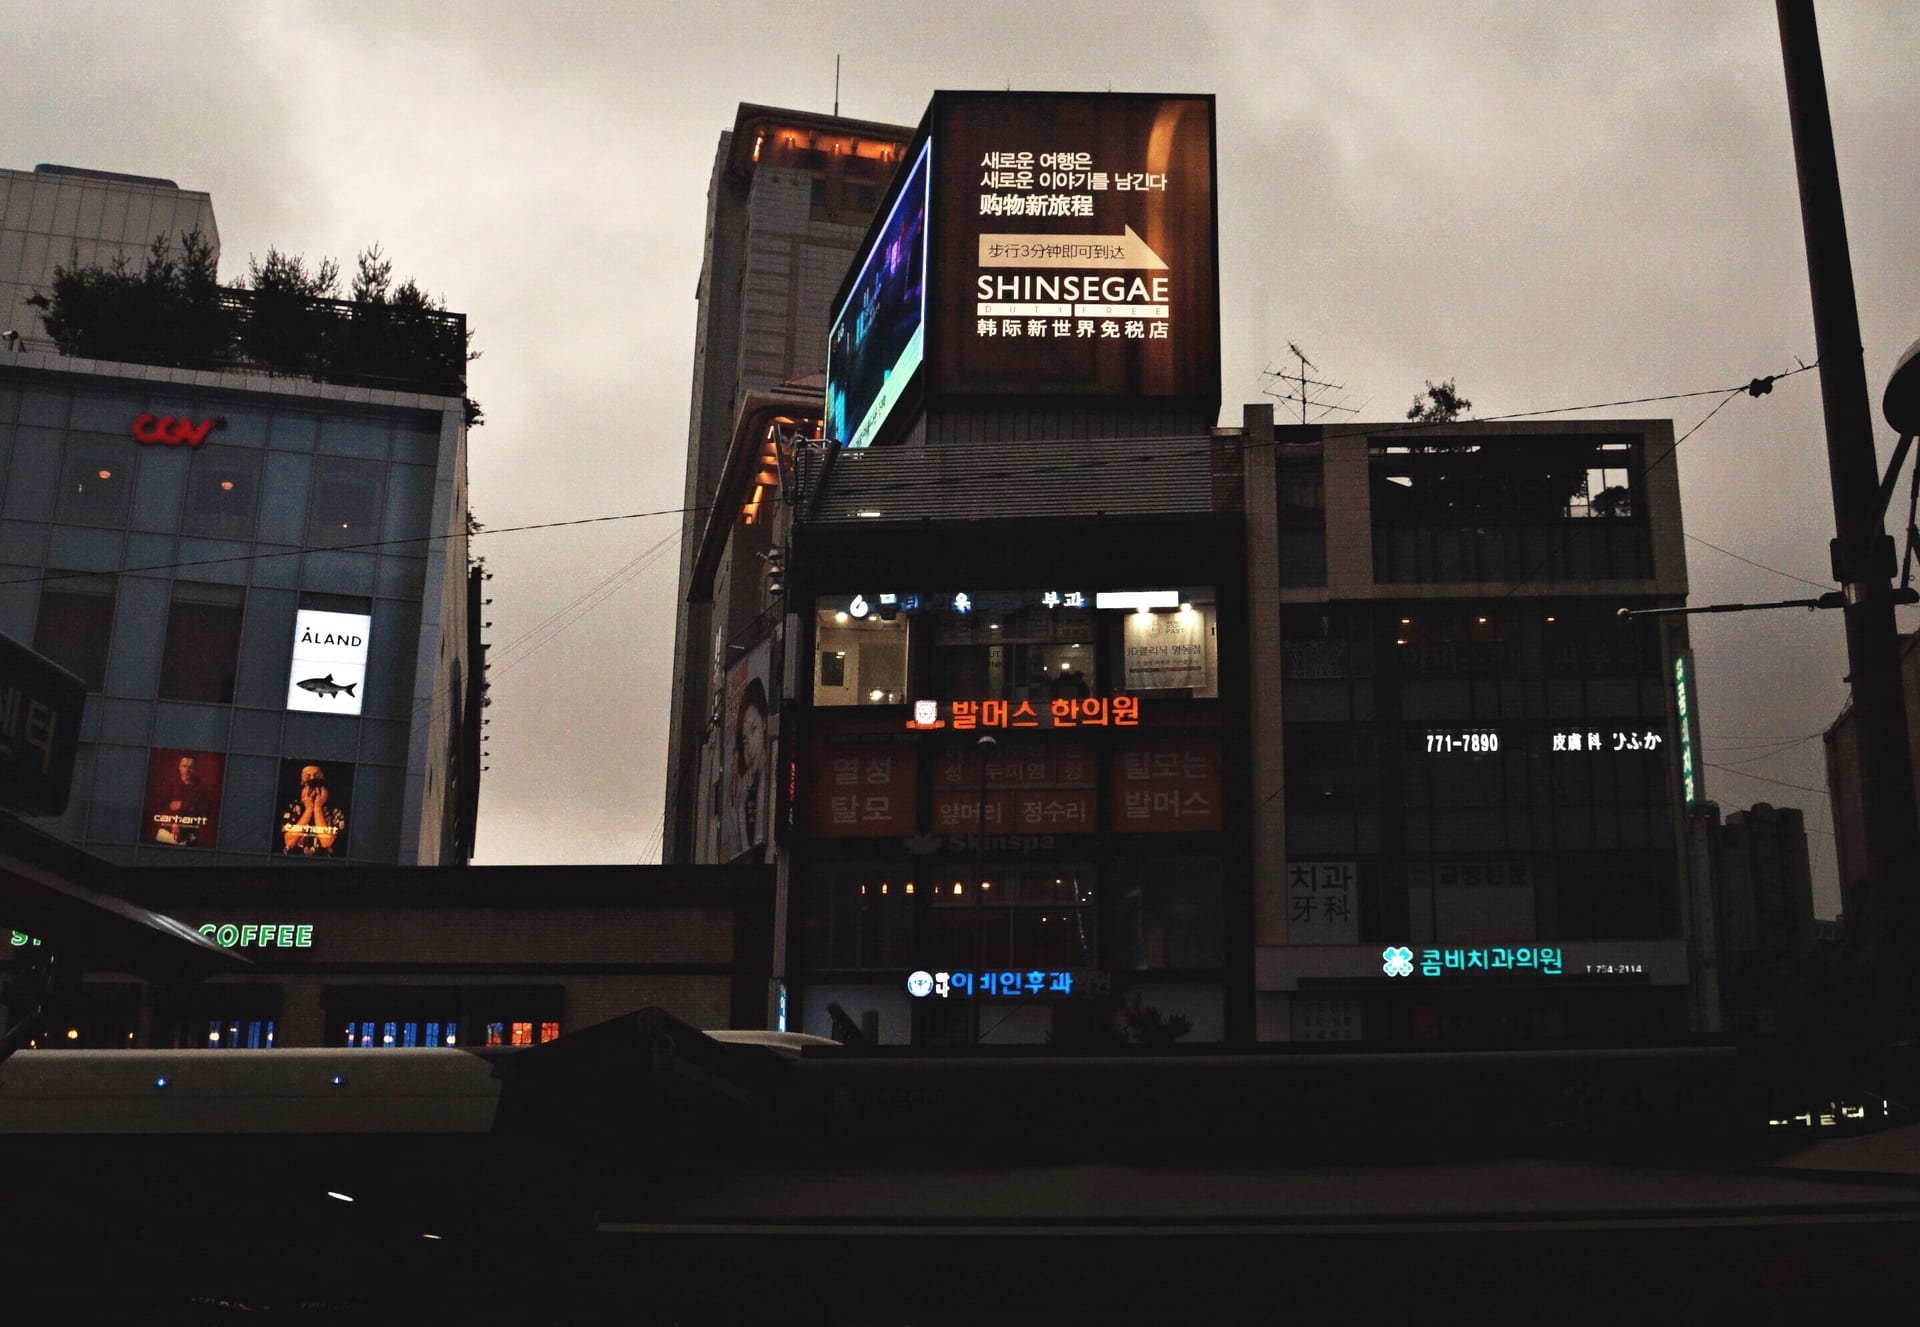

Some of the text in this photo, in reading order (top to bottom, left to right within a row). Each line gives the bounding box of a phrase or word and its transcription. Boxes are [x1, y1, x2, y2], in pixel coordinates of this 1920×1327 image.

[980, 151, 1093, 170] 새로운 여행은
[980, 171, 1168, 191] 새로운 이야기를 남긴다
[980, 195, 1094, 217] 购物新旅程
[988, 243, 1125, 260] 步行3分钟即可到达
[977, 275, 1169, 302] SHINSEGAE
[977, 319, 1169, 339] 韩际新世界免税店
[132, 412, 213, 447] CGV
[951, 695, 1140, 730] 발머스 한의원
[1426, 733, 1498, 752] 771-7890
[1612, 731, 1662, 751] ひふか
[831, 756, 892, 787] 열성
[830, 792, 893, 824] 탈모
[939, 802, 1002, 825] 앞머리
[1022, 799, 1086, 823] 정수리
[1123, 788, 1212, 820] 발머스
[153, 814, 208, 826] carhartt
[948, 833, 1056, 854] Skinspa
[1290, 864, 1353, 893] 치과
[1290, 895, 1352, 924] 牙科
[1420, 946, 1564, 977] 콤비치과의원
